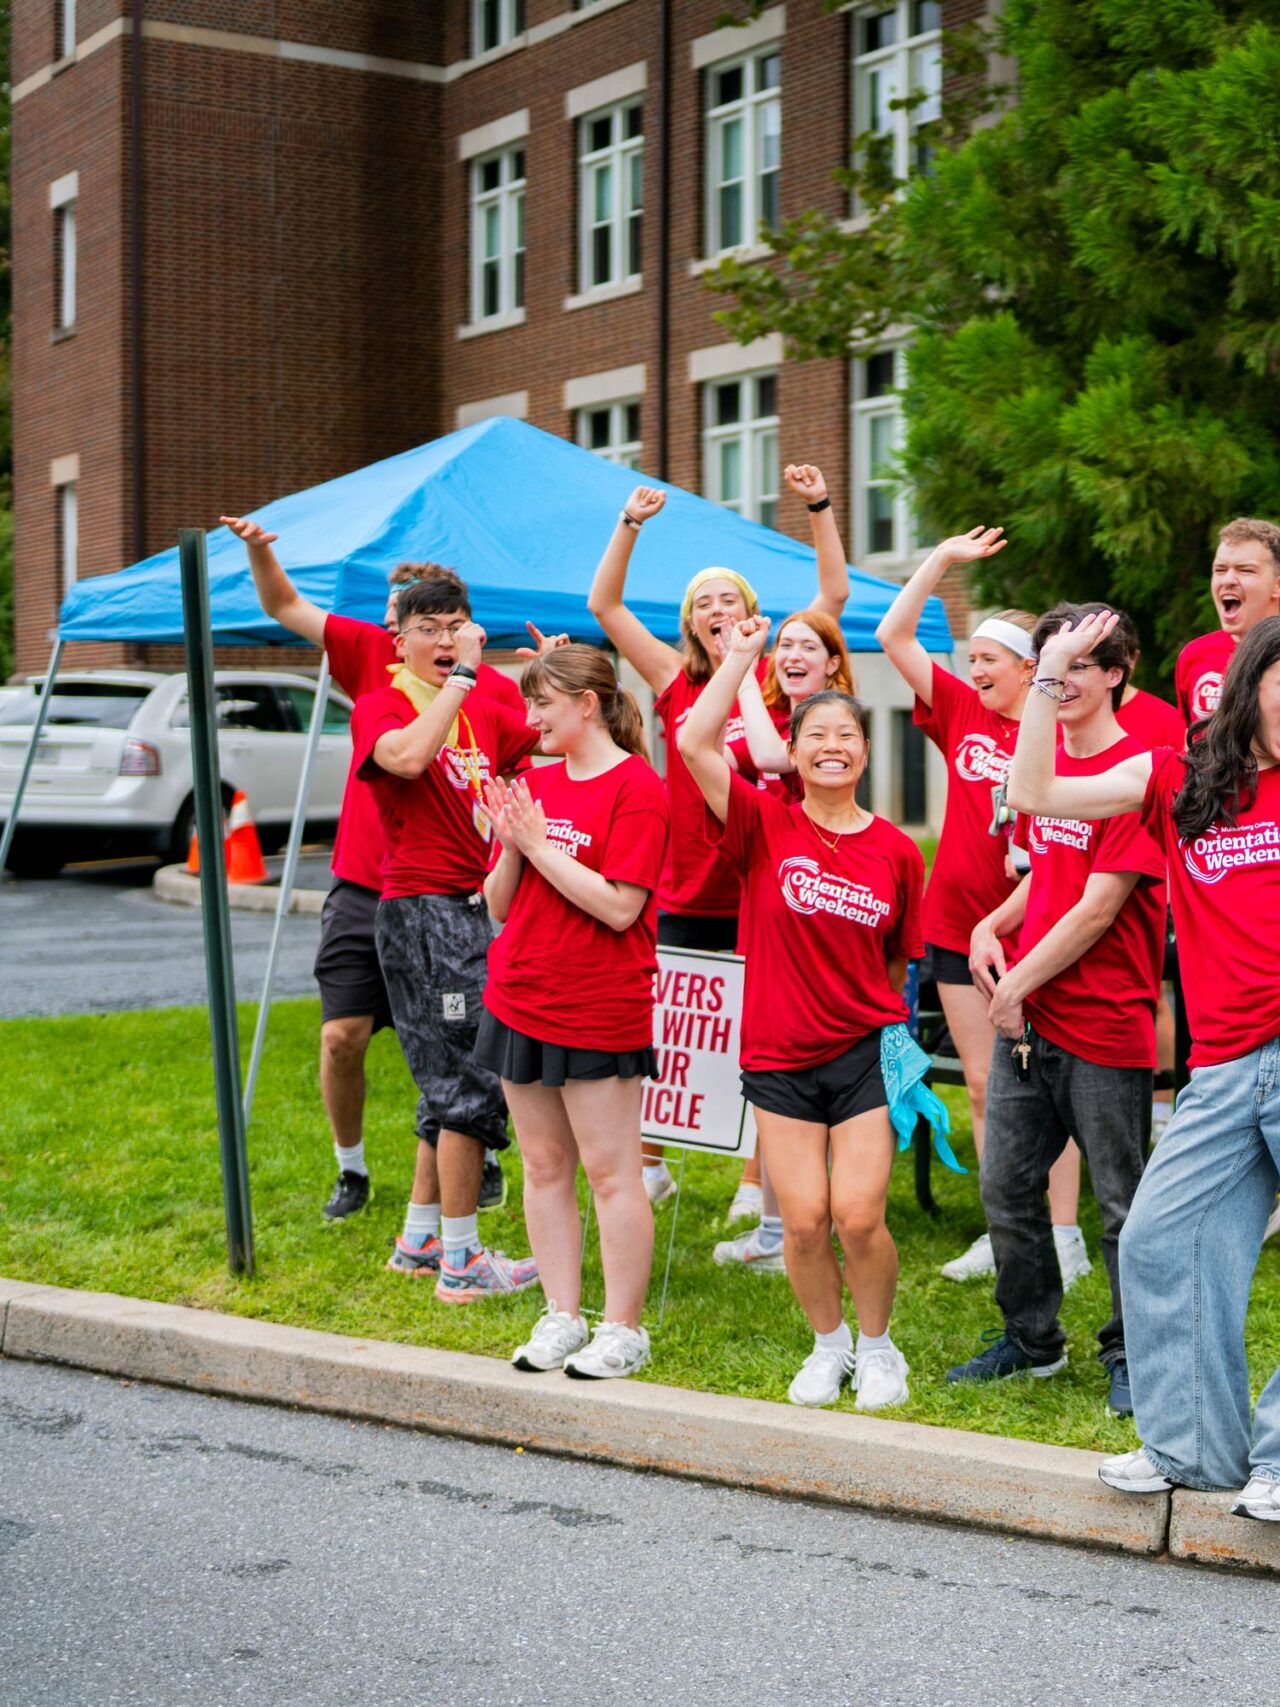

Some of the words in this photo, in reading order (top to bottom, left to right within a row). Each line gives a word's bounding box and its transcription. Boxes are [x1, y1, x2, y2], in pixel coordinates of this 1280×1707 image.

[791, 870, 891, 916] Orientation
[799, 886, 881, 928] Weekend
[656, 967, 725, 1013] VERS
[663, 1008, 732, 1053] WITH
[653, 1047, 690, 1088] UR
[641, 1084, 705, 1130] ICLE
